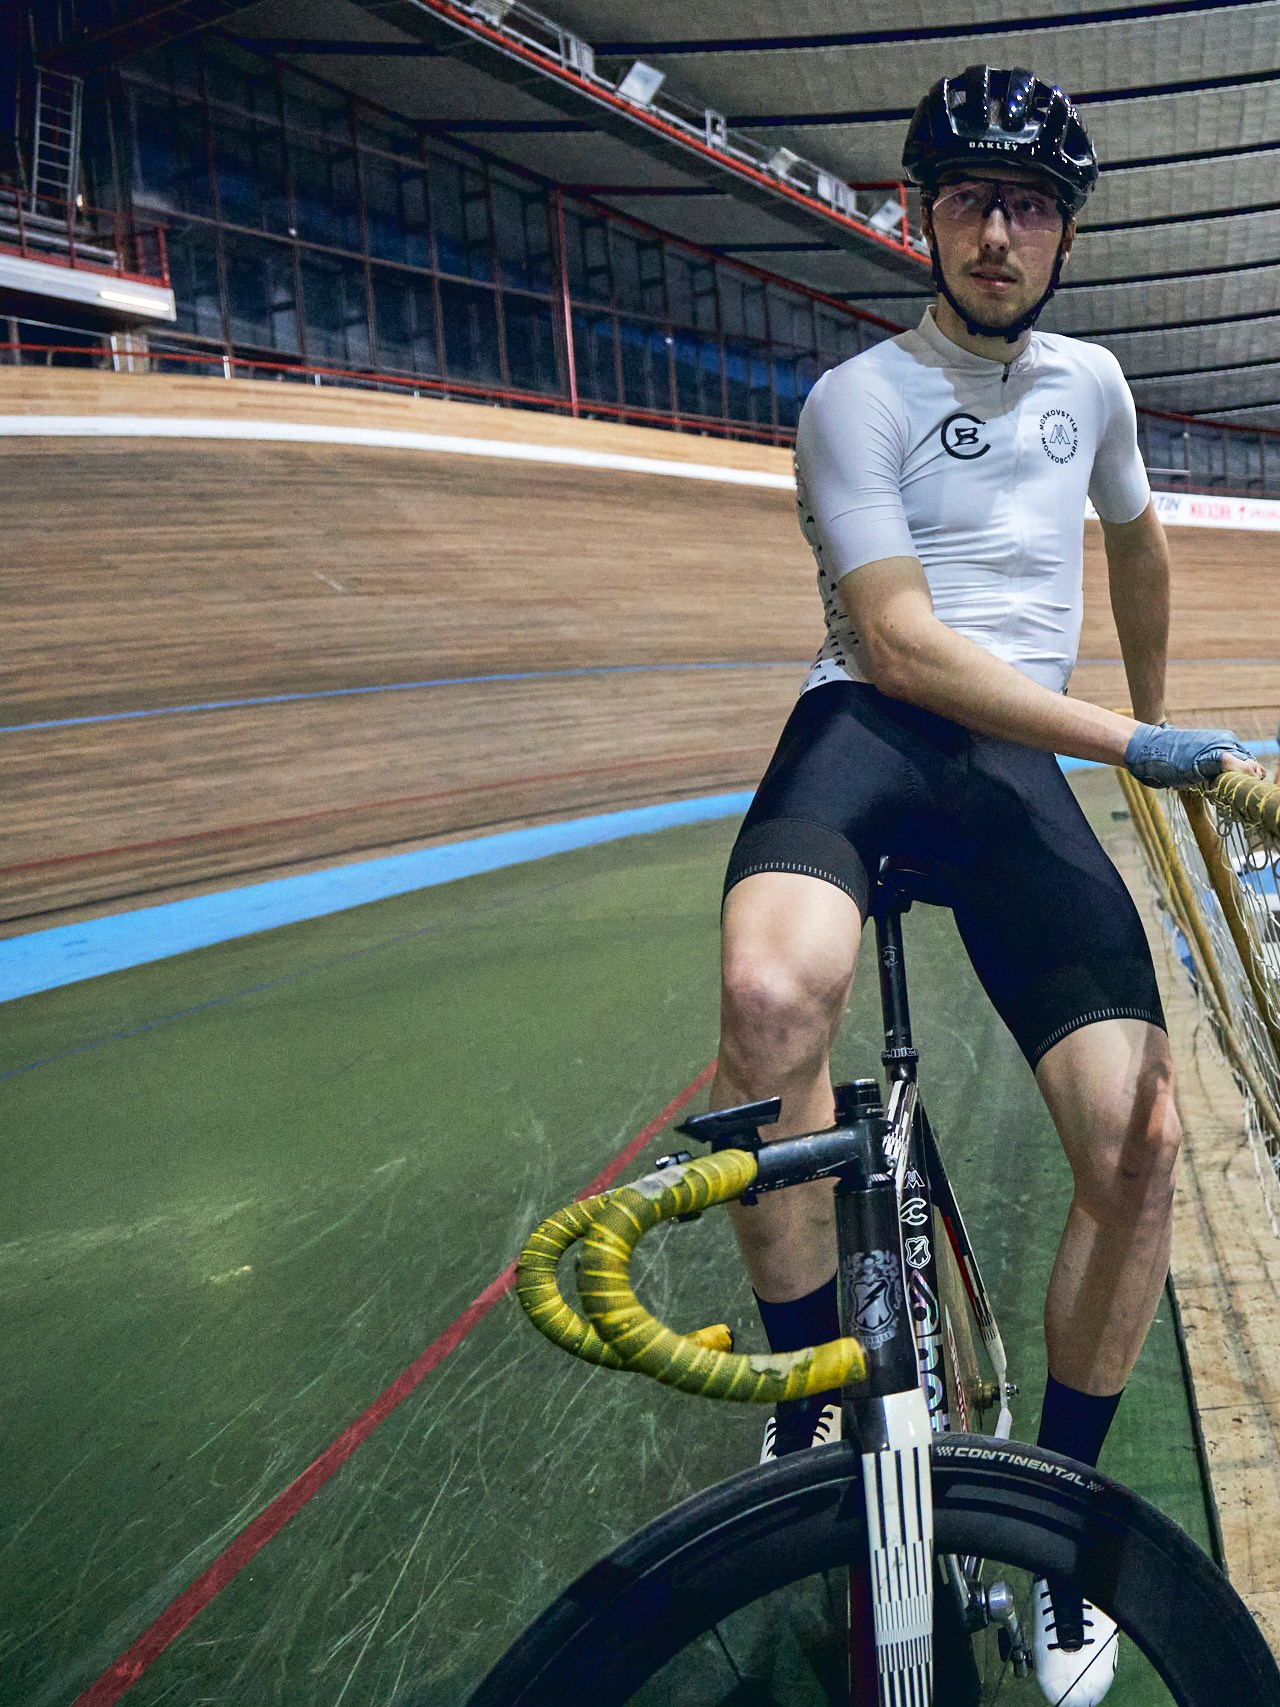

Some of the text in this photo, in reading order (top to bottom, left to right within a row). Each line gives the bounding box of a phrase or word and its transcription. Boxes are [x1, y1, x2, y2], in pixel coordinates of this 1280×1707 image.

[969, 141, 1018, 151] OAKLEY
[1039, 409, 1078, 431] MOSKOVSTYLE
[954, 1447, 1086, 1486] CONTINENTAL
